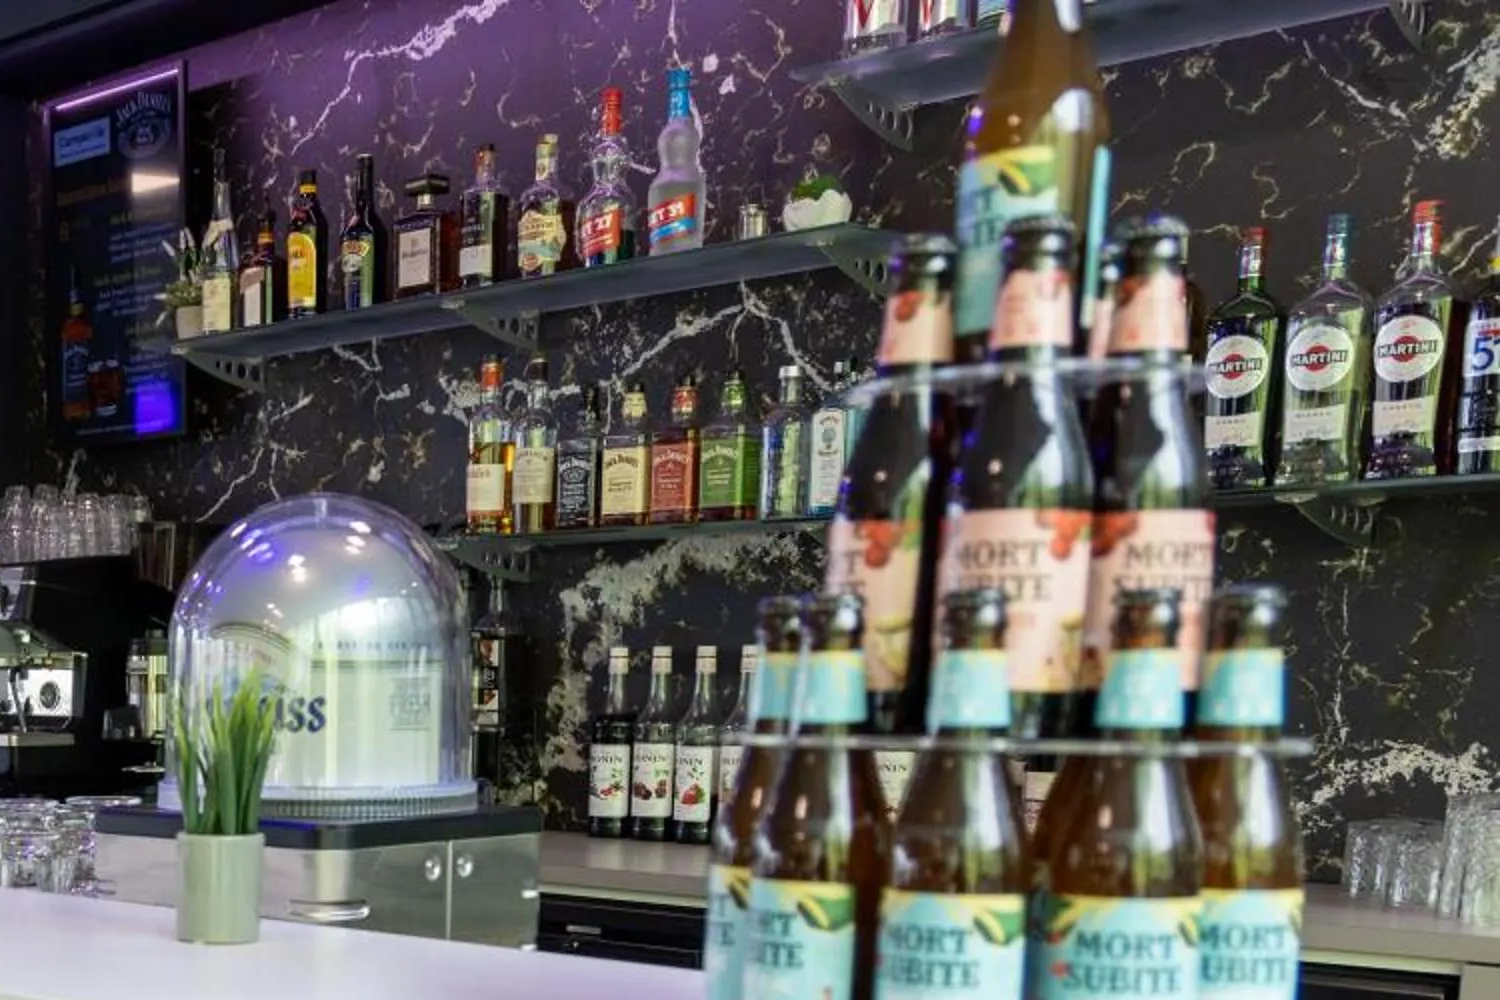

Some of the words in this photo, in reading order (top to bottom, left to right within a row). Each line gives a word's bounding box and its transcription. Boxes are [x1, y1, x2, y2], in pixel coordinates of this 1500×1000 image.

[1291, 349, 1349, 368] MARTINI
[1377, 339, 1438, 358] MARTINI
[1471, 336, 1500, 371] 5
[1209, 357, 1263, 375] MARTINI
[1074, 930, 1179, 961] MORT
[1062, 960, 1184, 995] SUBITE
